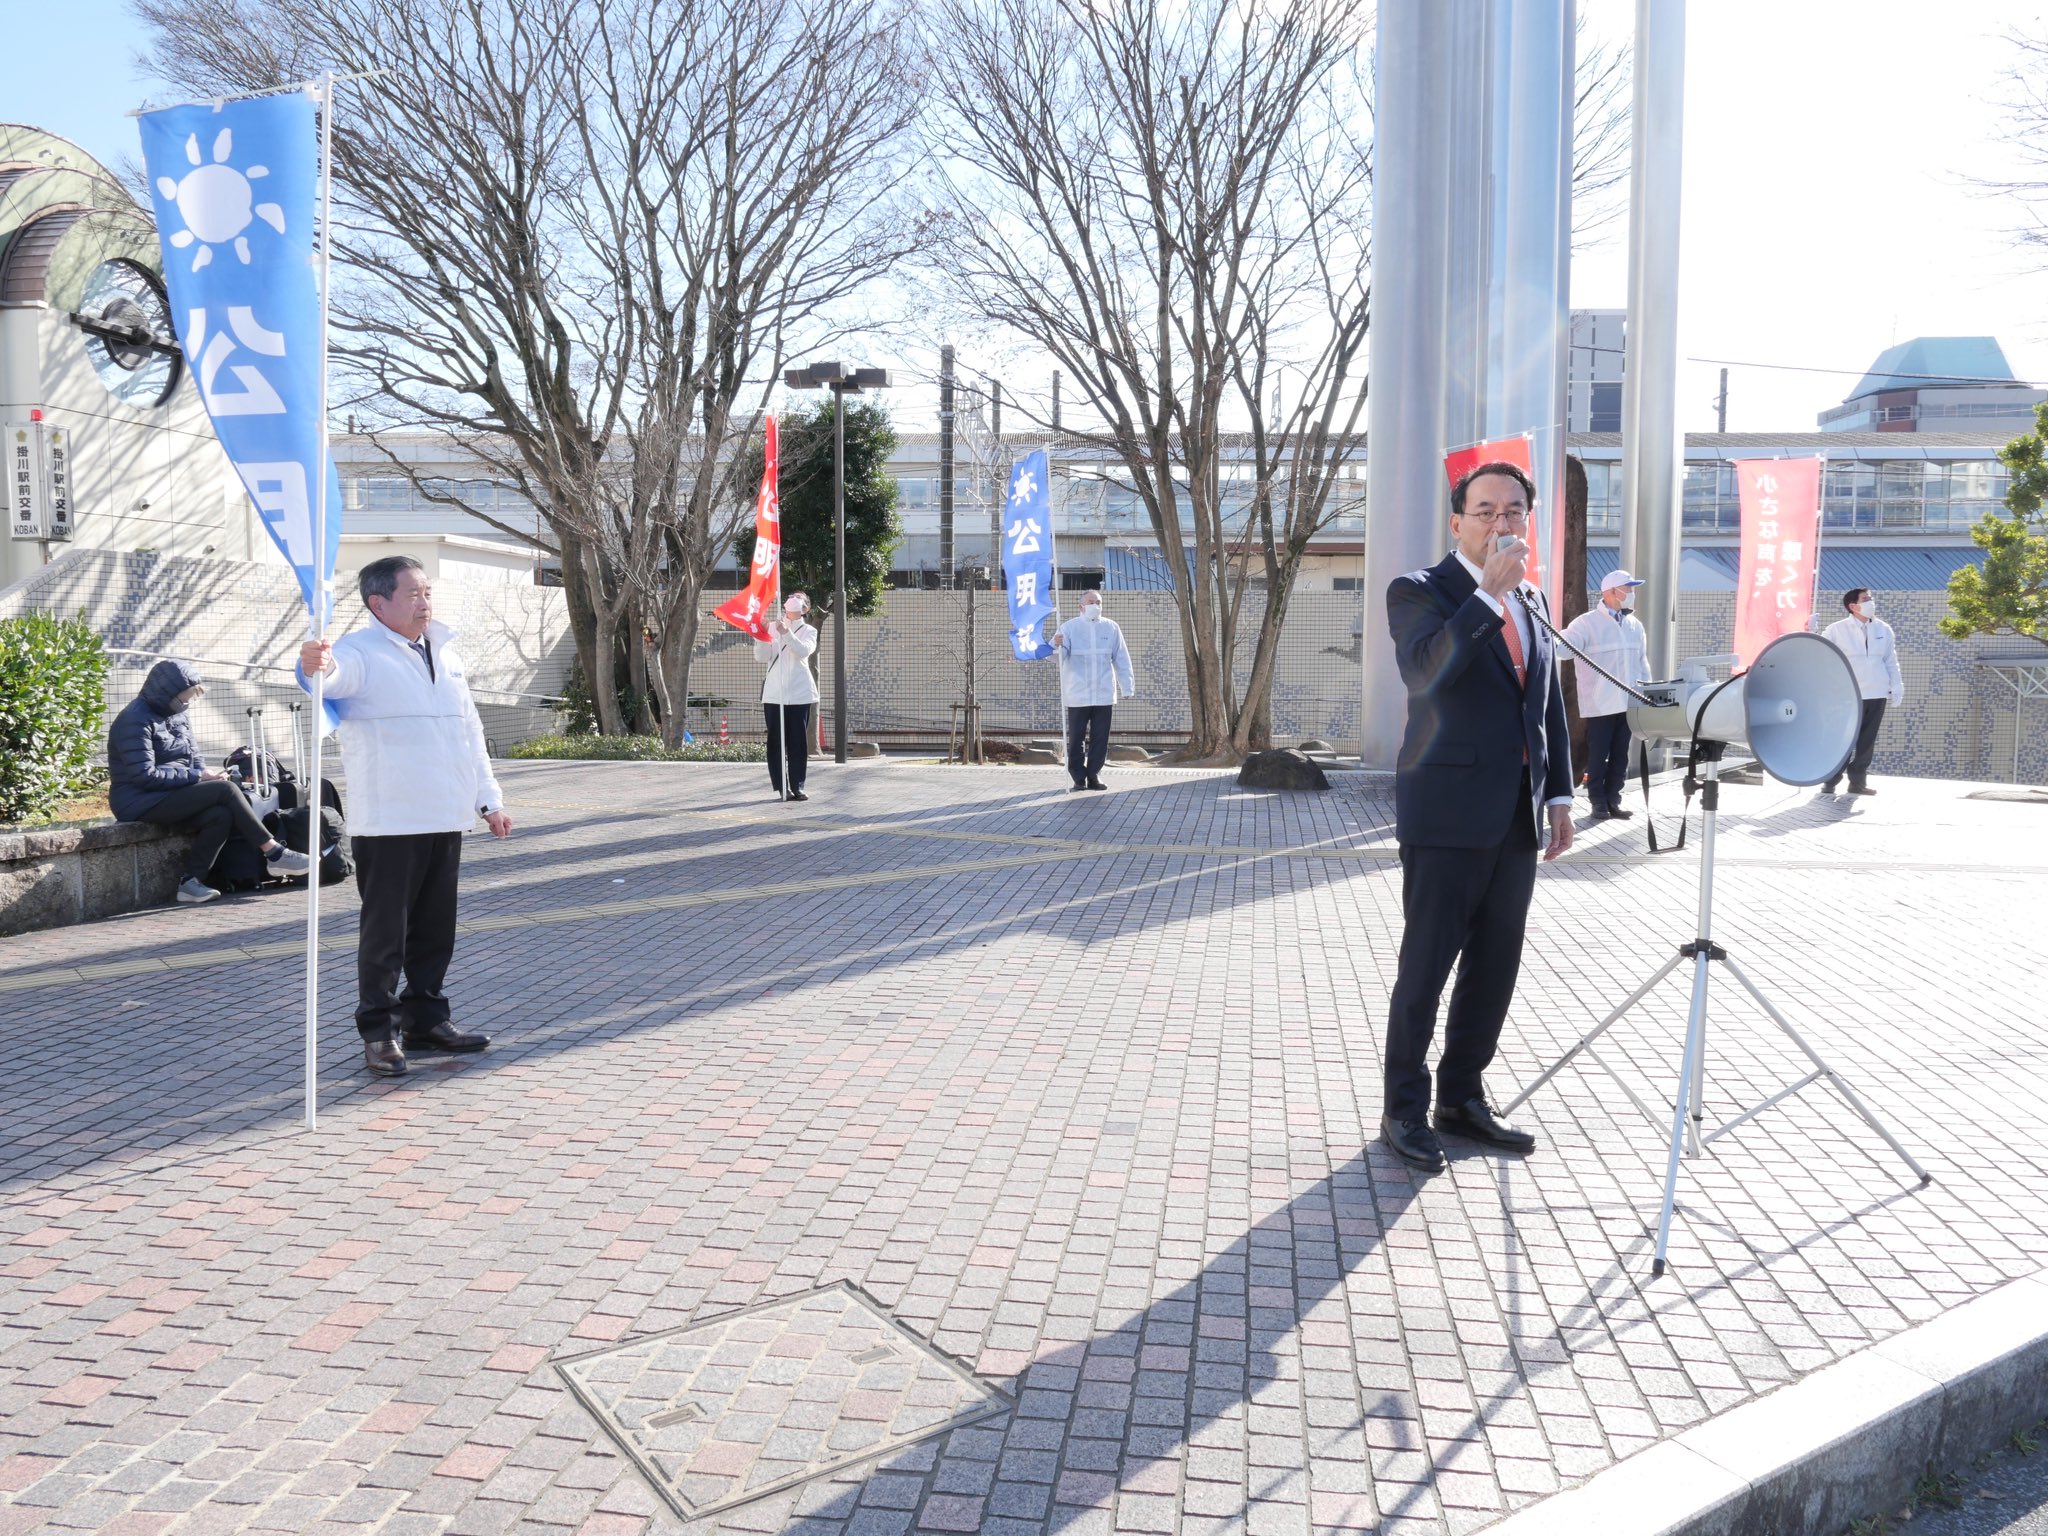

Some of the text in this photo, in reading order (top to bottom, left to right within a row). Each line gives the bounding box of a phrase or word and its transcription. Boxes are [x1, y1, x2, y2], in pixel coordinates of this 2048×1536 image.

[16, 445, 32, 522] 掛川駅前交番
[53, 447, 67, 523] 掛川駅前交番
[14, 524, 39, 535] KOBAN
[51, 525, 72, 536] KOBAN
